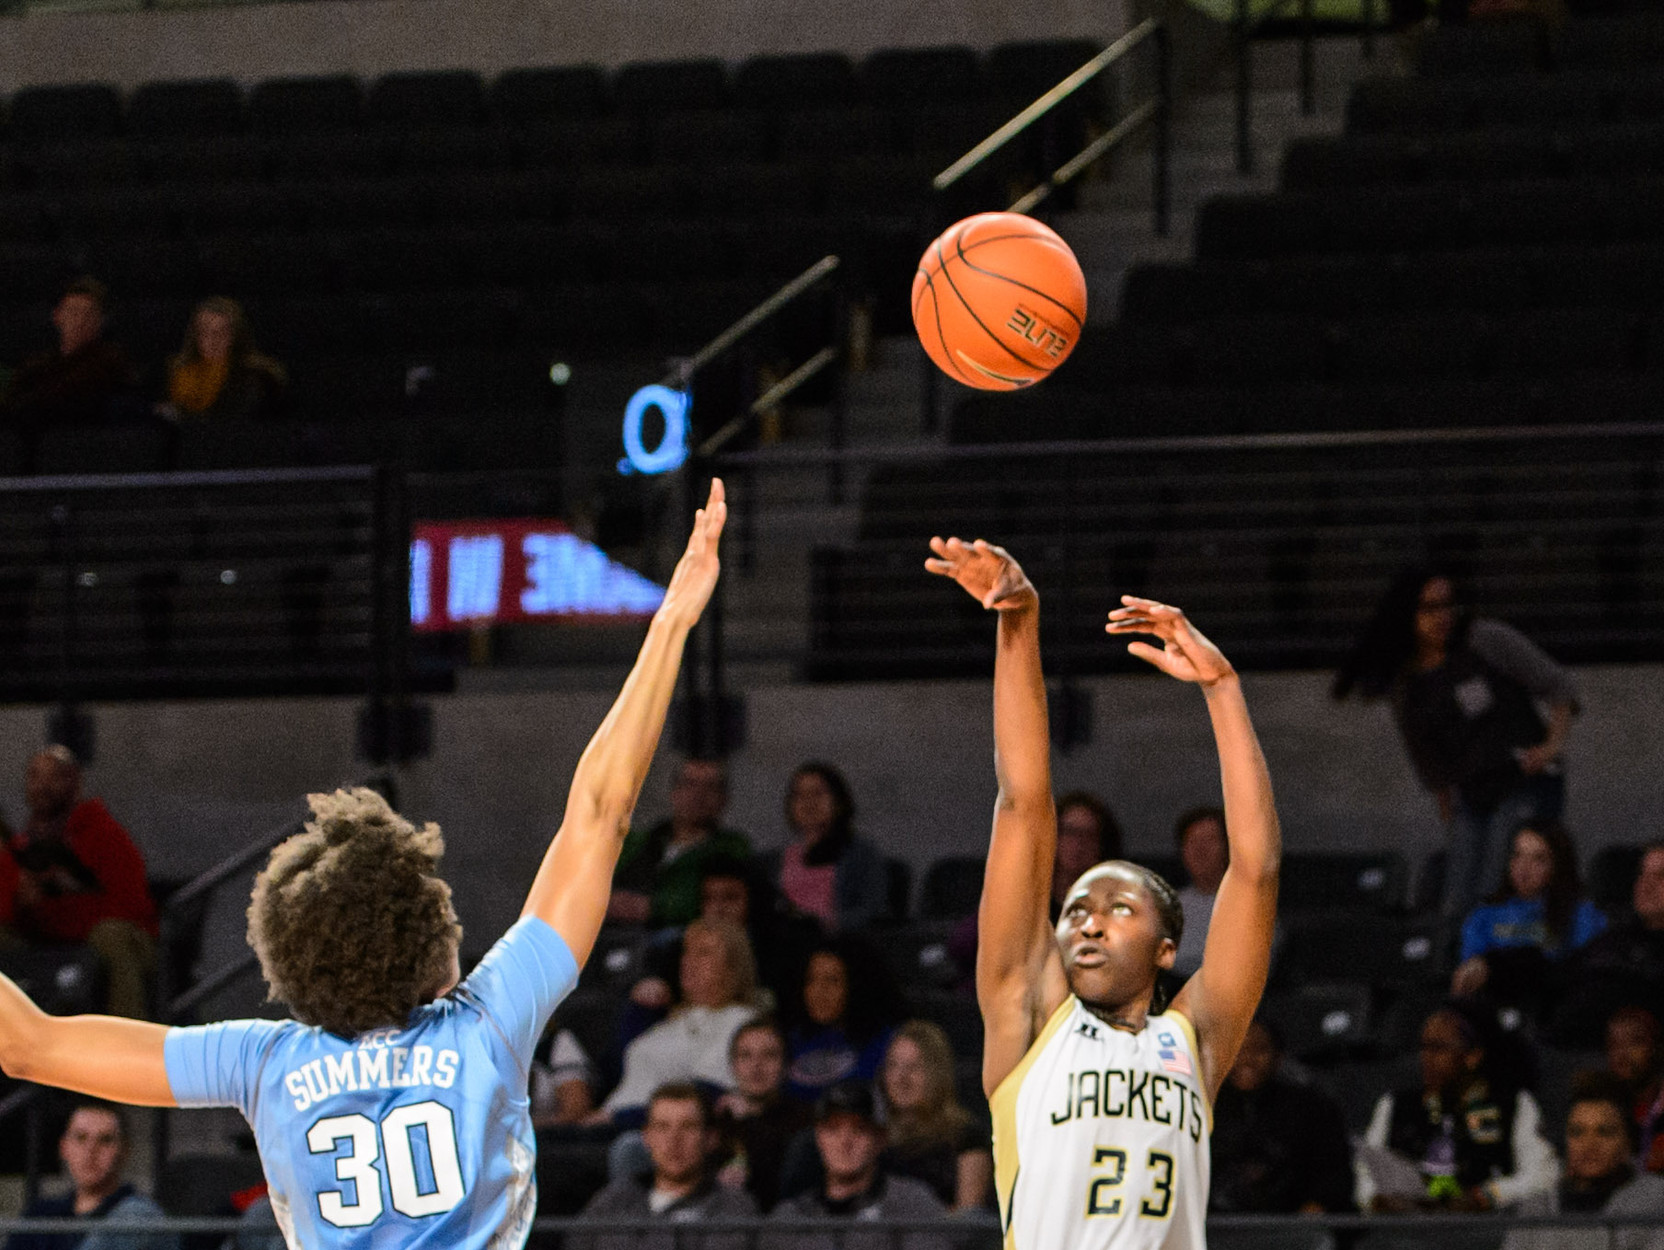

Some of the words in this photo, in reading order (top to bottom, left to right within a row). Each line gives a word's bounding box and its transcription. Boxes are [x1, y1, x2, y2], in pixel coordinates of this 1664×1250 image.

[1006, 309, 1067, 358] ELITE
[285, 1045, 459, 1112] SUMMERS
[1051, 1068, 1203, 1144] JACKETS
[306, 1099, 466, 1228] 30
[1085, 1145, 1178, 1220] 23
